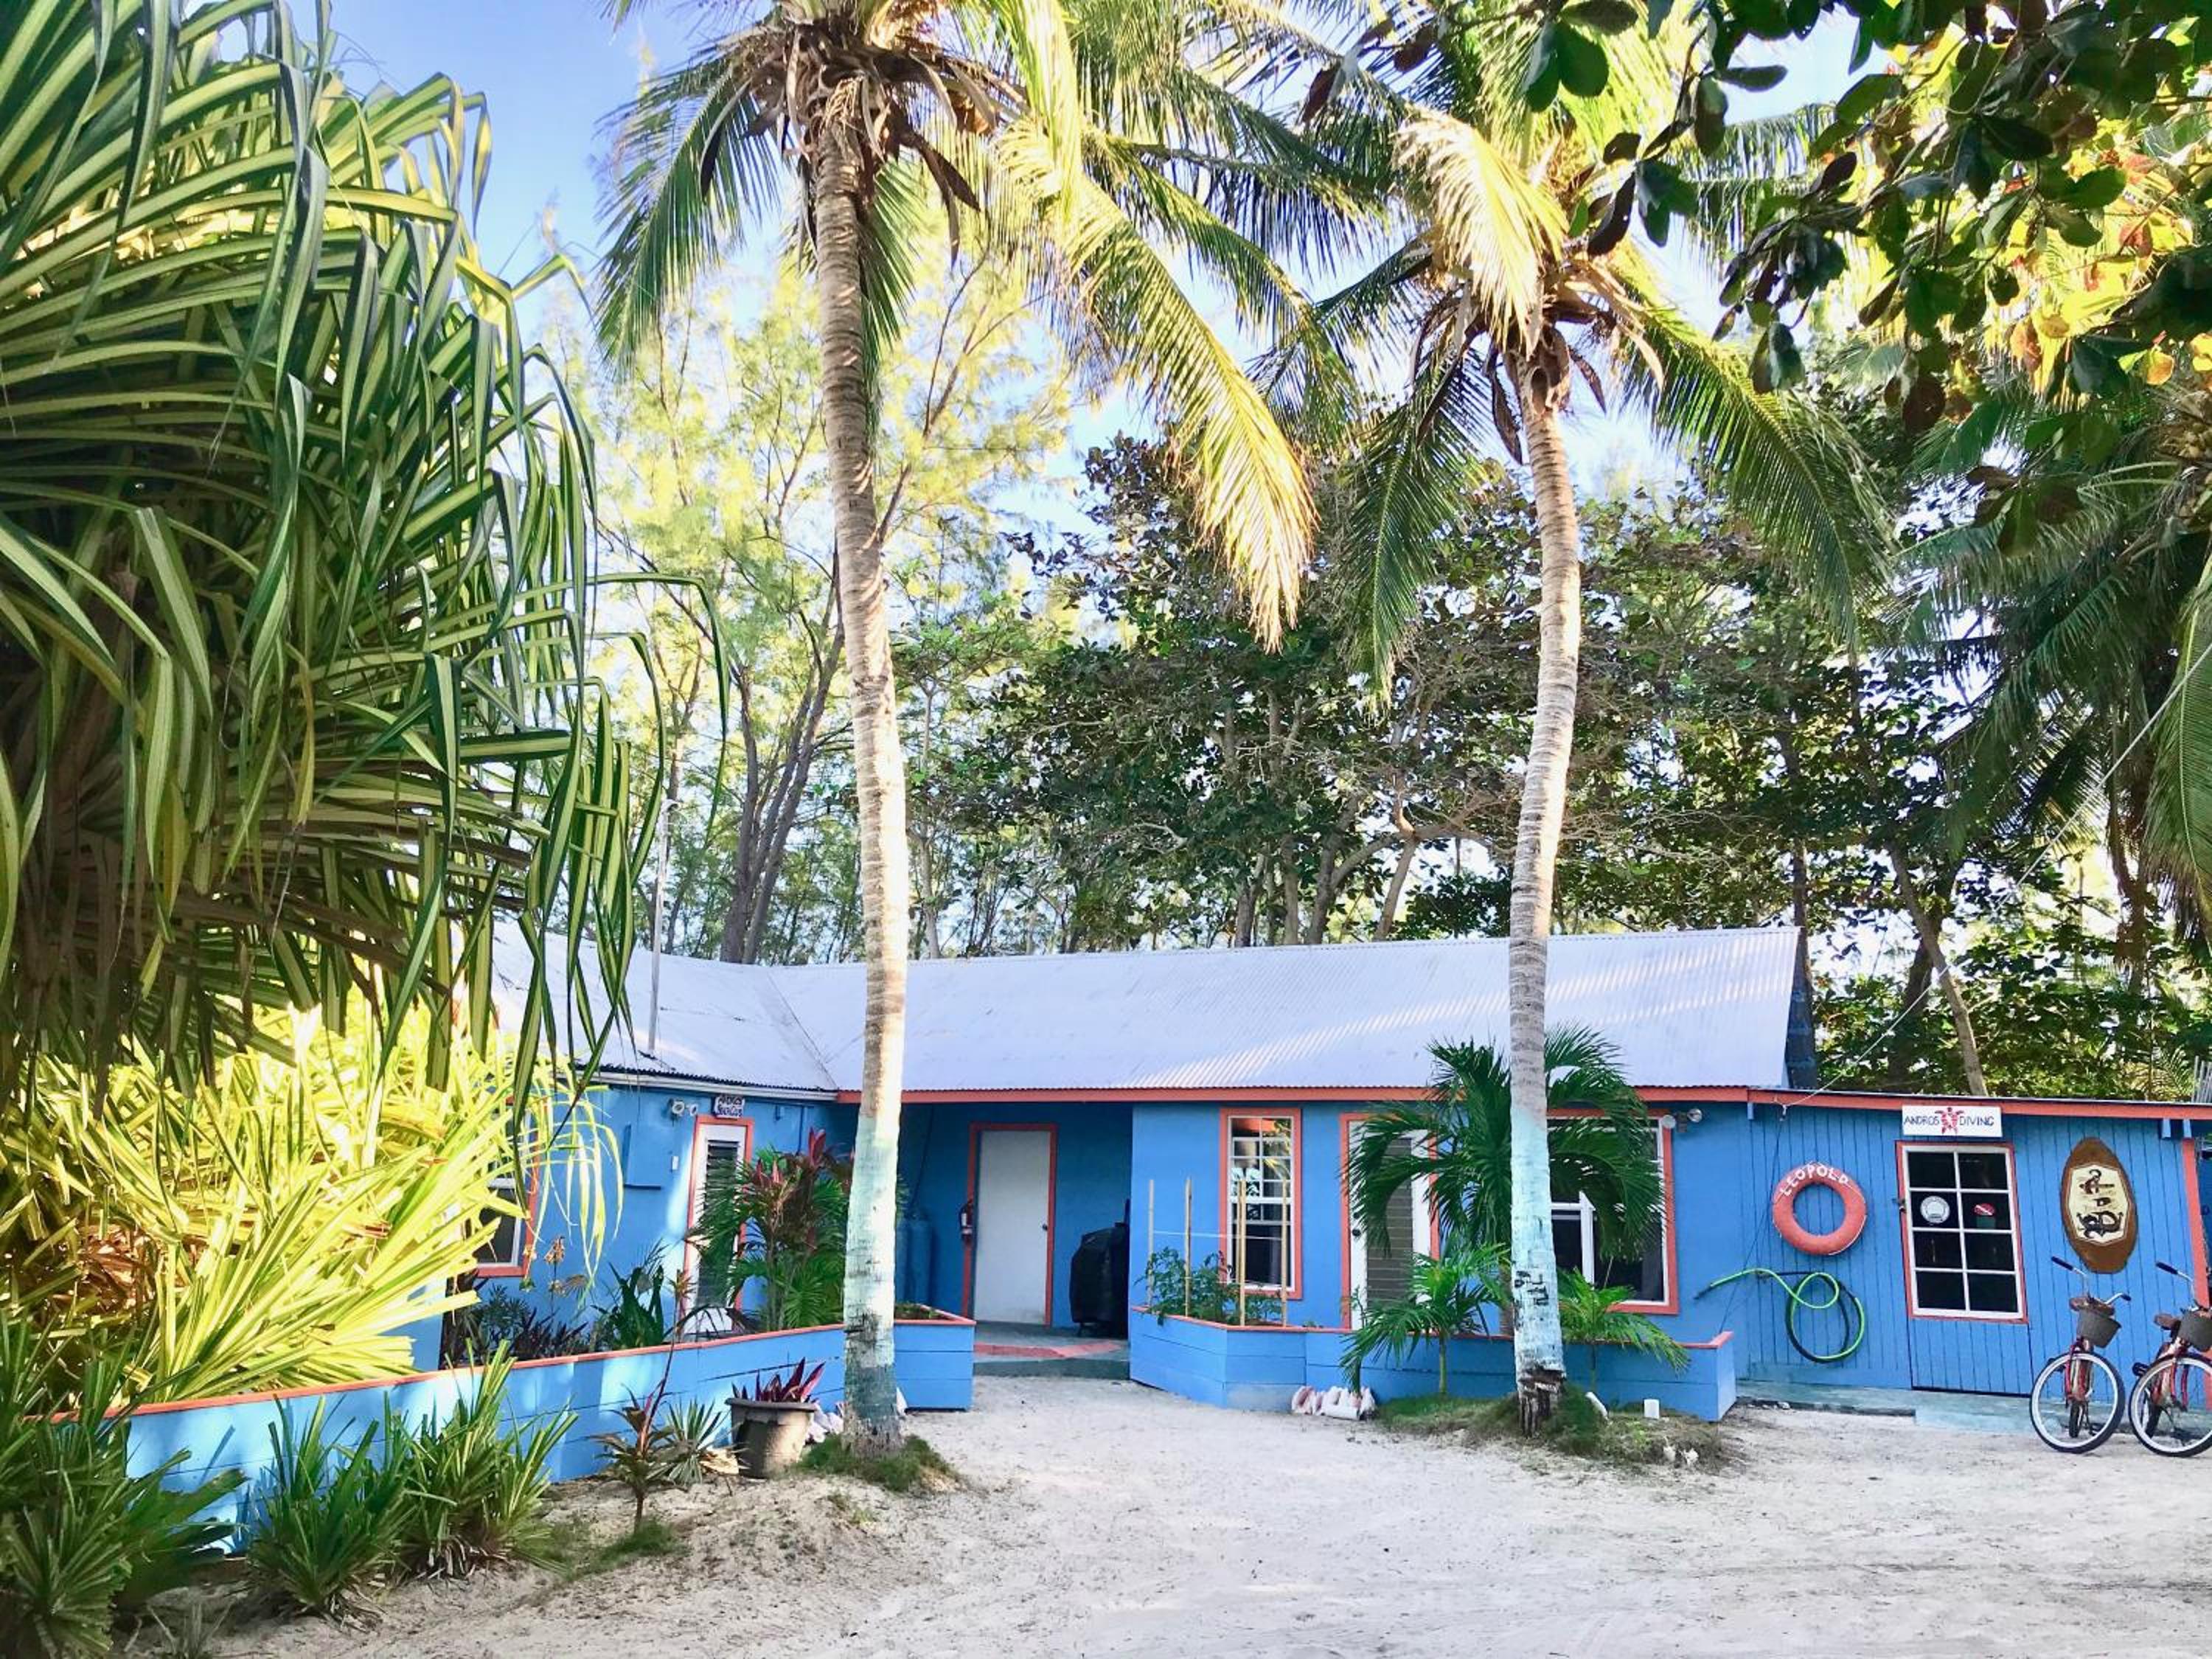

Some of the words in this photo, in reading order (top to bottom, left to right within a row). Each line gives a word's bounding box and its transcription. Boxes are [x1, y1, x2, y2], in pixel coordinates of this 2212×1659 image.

[1903, 1116, 1940, 1126] ANDROS
[1959, 1116, 1994, 1127] DIVING
[1779, 1164, 1849, 1196] LEOPOLD
